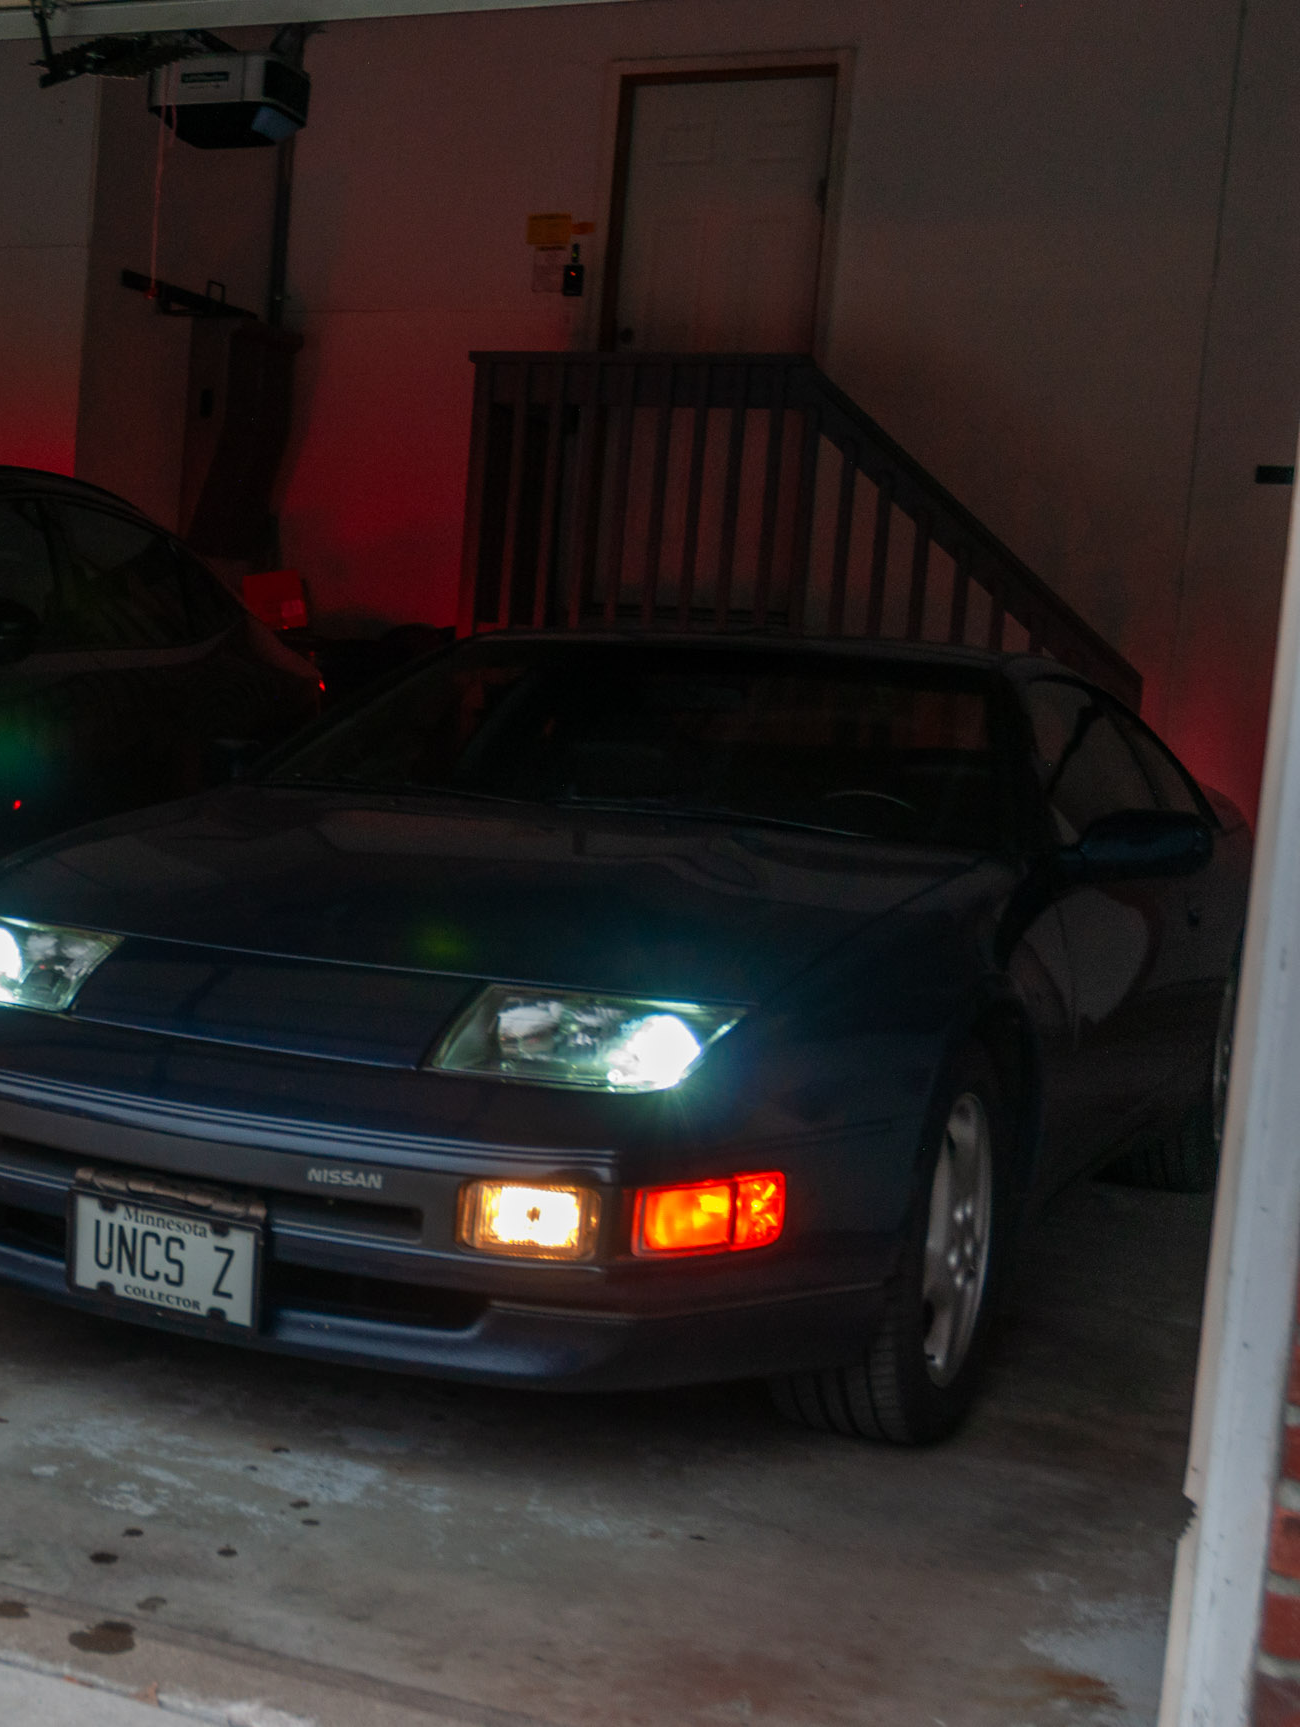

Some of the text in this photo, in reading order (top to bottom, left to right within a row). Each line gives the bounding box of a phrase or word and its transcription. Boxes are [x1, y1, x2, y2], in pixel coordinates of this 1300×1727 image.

[307, 1167, 383, 1190] NISSAN
[123, 1205, 208, 1239] Minnesota
[94, 1219, 235, 1300] UNCS Z
[124, 1284, 201, 1311] COLLECTOR
